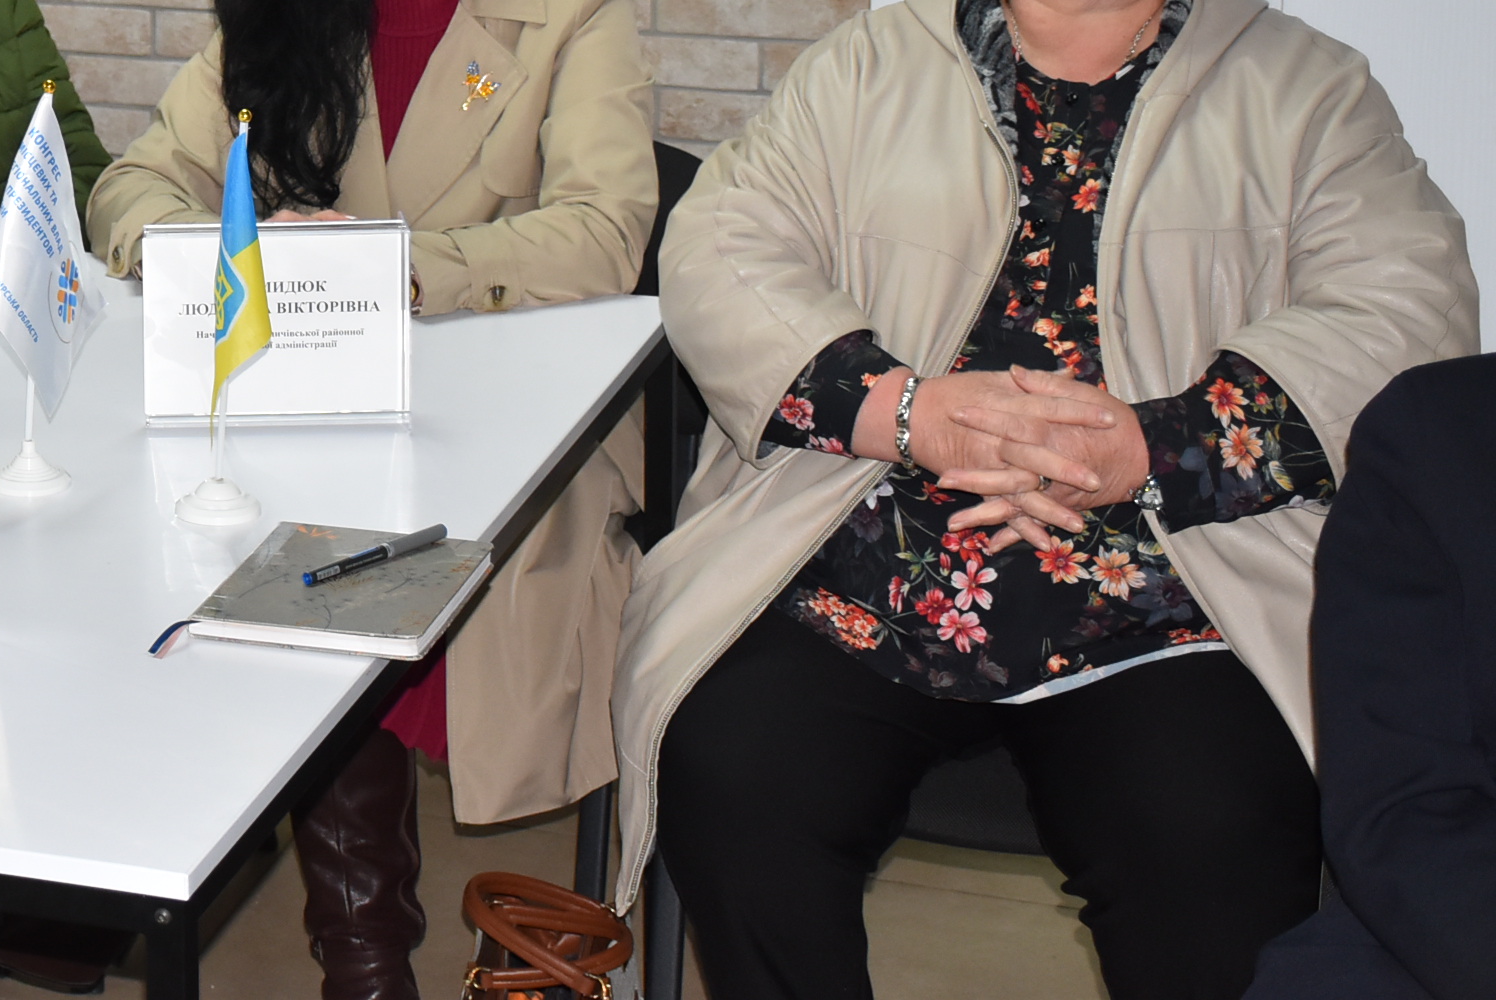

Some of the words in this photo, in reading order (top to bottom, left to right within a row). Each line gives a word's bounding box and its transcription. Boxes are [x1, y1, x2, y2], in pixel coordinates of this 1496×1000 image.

[28, 126, 62, 182] КОНГРЕС
[12, 161, 53, 226] ГІОНАЛЬНИХ
[51, 224, 63, 255] ВЛАД
[49, 189, 58, 206] ТА
[6, 185, 55, 258] ПРЕЗИДЕНТОВІ
[277, 300, 381, 314] ВІКТОРІВНА
[17, 310, 39, 343] ОБЛАСТЬ
[321, 328, 365, 338] районної
[275, 339, 338, 350] адміністрації
